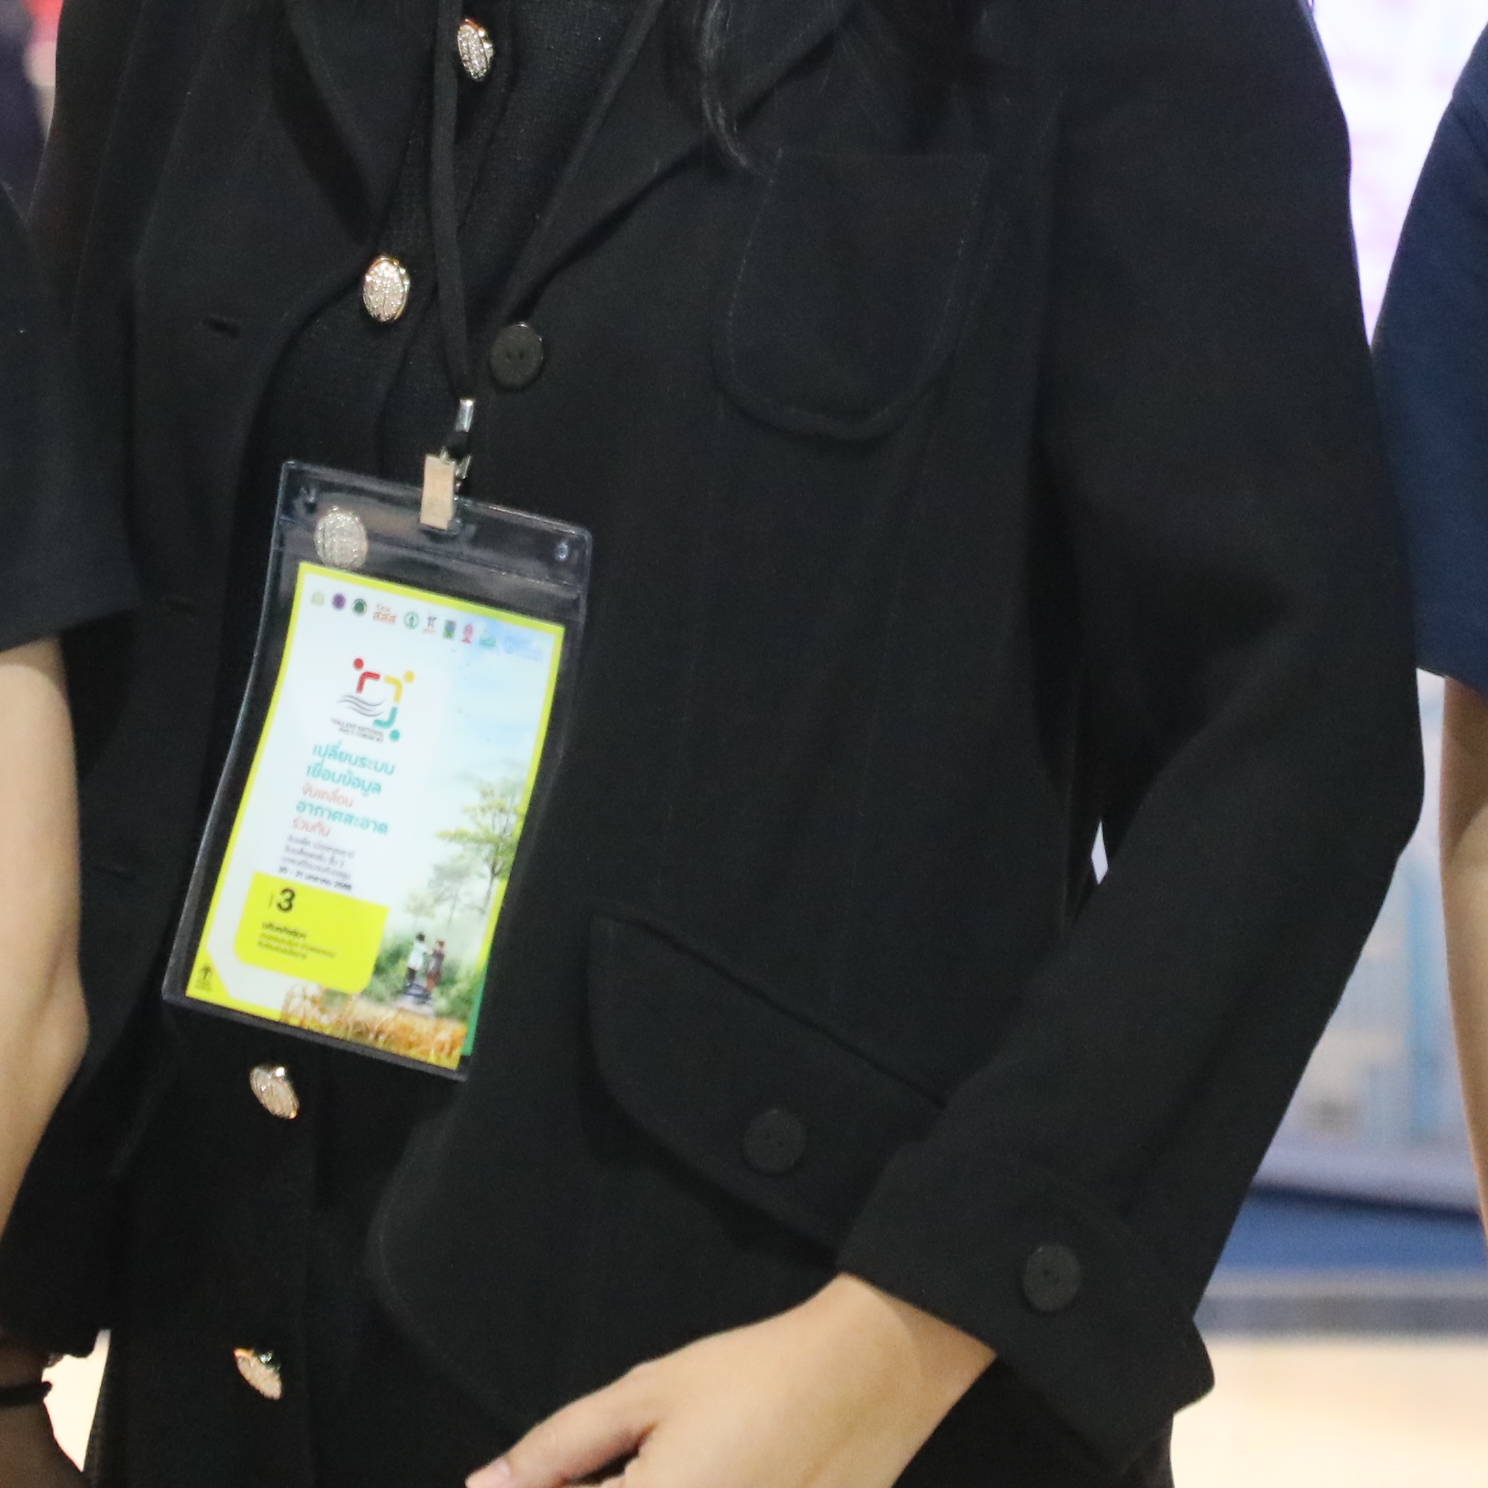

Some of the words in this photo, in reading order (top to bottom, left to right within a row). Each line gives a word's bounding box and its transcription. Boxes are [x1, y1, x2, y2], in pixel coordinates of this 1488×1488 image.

[312, 741, 395, 775] เปลี่ยนระบบ
[306, 758, 382, 797] เชื่อมข้อมูล
[277, 888, 295, 913] 3
